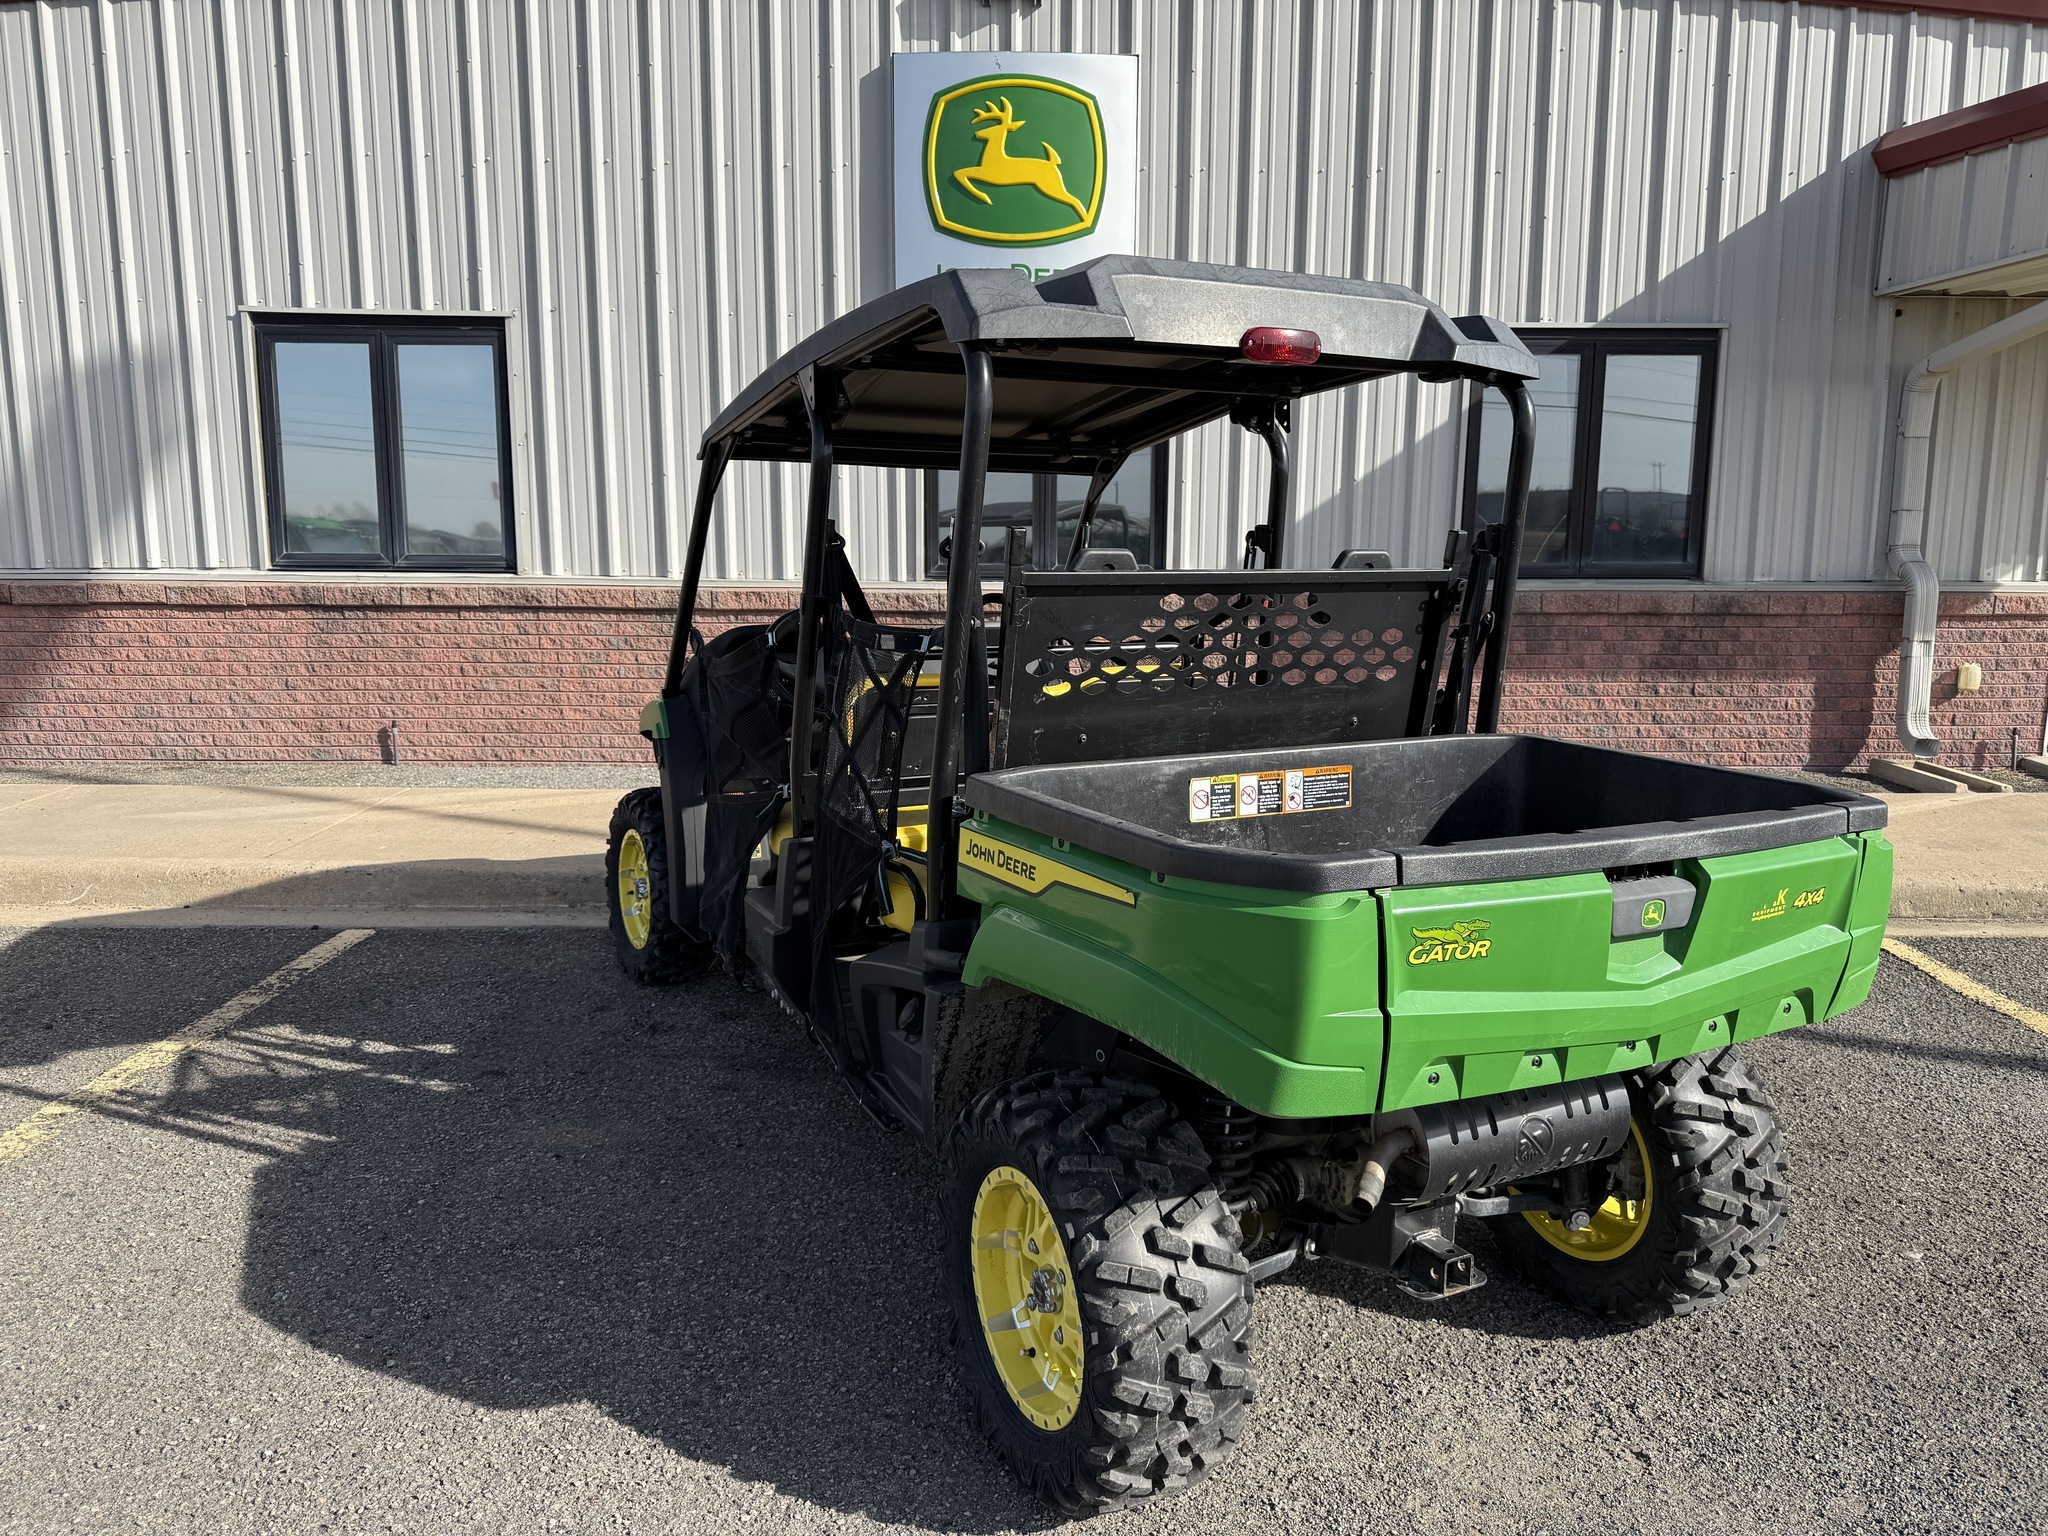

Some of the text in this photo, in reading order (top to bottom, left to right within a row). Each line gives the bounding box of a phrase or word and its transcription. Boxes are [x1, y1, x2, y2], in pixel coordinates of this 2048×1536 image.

[966, 839, 1037, 881] JOHN DEERE
[1408, 940, 1492, 965] GATOR
